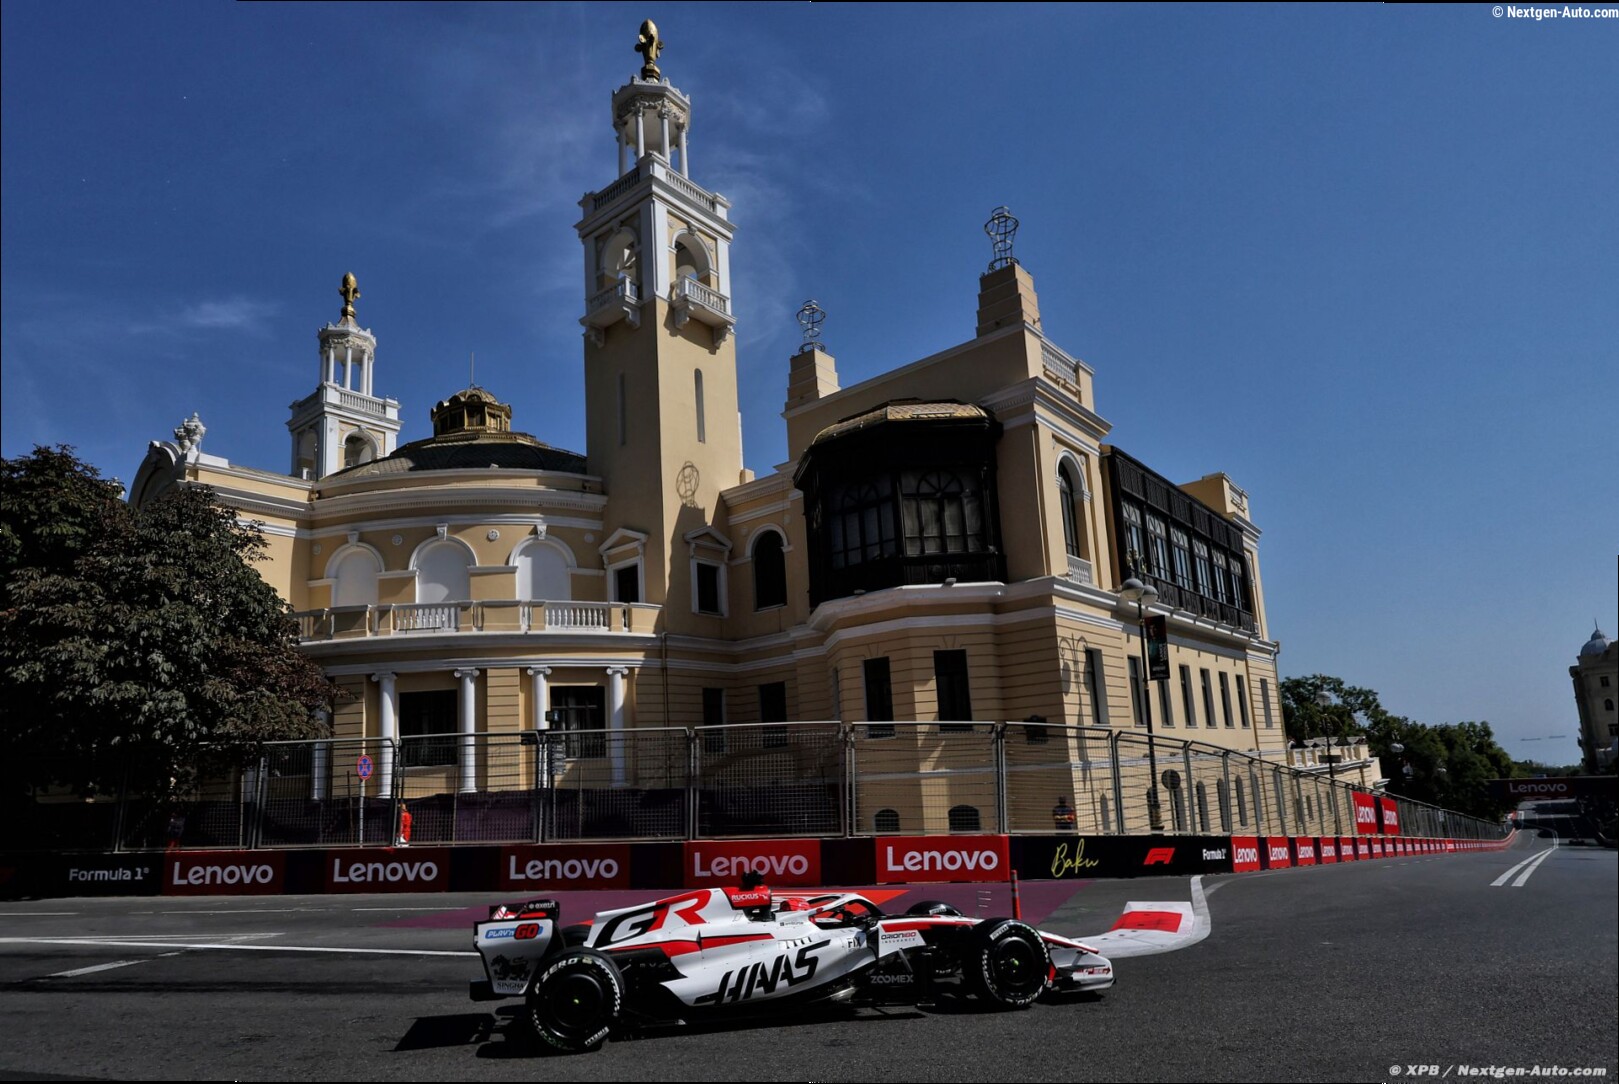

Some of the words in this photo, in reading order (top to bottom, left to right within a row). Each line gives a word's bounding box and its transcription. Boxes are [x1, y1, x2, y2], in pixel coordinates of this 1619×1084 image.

[1509, 783, 1568, 793] Lenovo
[886, 846, 999, 872] Lenovo
[1051, 838, 1100, 878] Baku
[1233, 844, 1258, 864] Lenovo
[1268, 843, 1289, 861] Lenovo
[69, 868, 131, 881] Formula
[173, 862, 273, 885] Lenovo
[333, 858, 438, 883] Lenovo
[509, 855, 618, 880] Lenovo
[694, 852, 809, 878] Lenovo
[515, 924, 539, 939] GO
[693, 938, 832, 1006] HAAS
[870, 974, 914, 984] ZOOMEX
